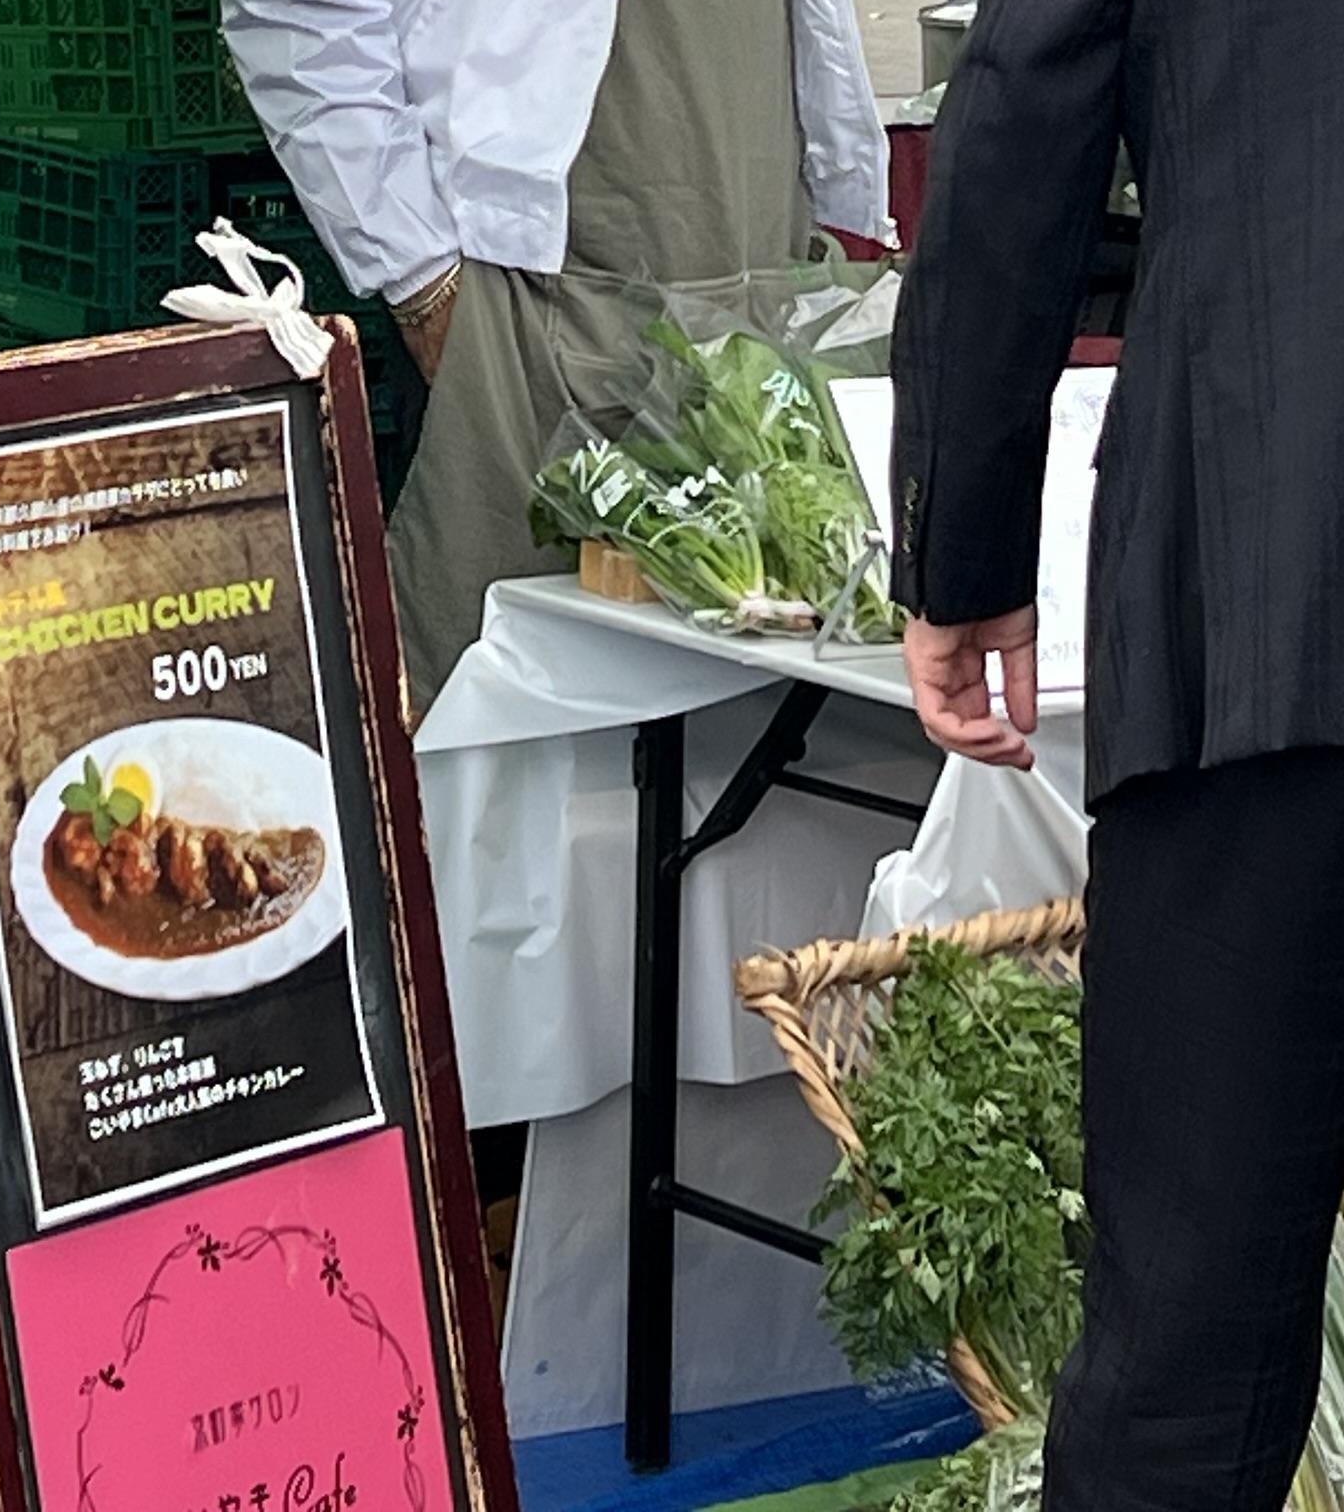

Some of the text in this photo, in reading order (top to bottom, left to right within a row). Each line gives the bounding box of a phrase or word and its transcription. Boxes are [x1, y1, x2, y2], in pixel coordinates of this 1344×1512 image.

[153, 578, 275, 631] CURRY
[152, 645, 268, 701] 500 YEN
